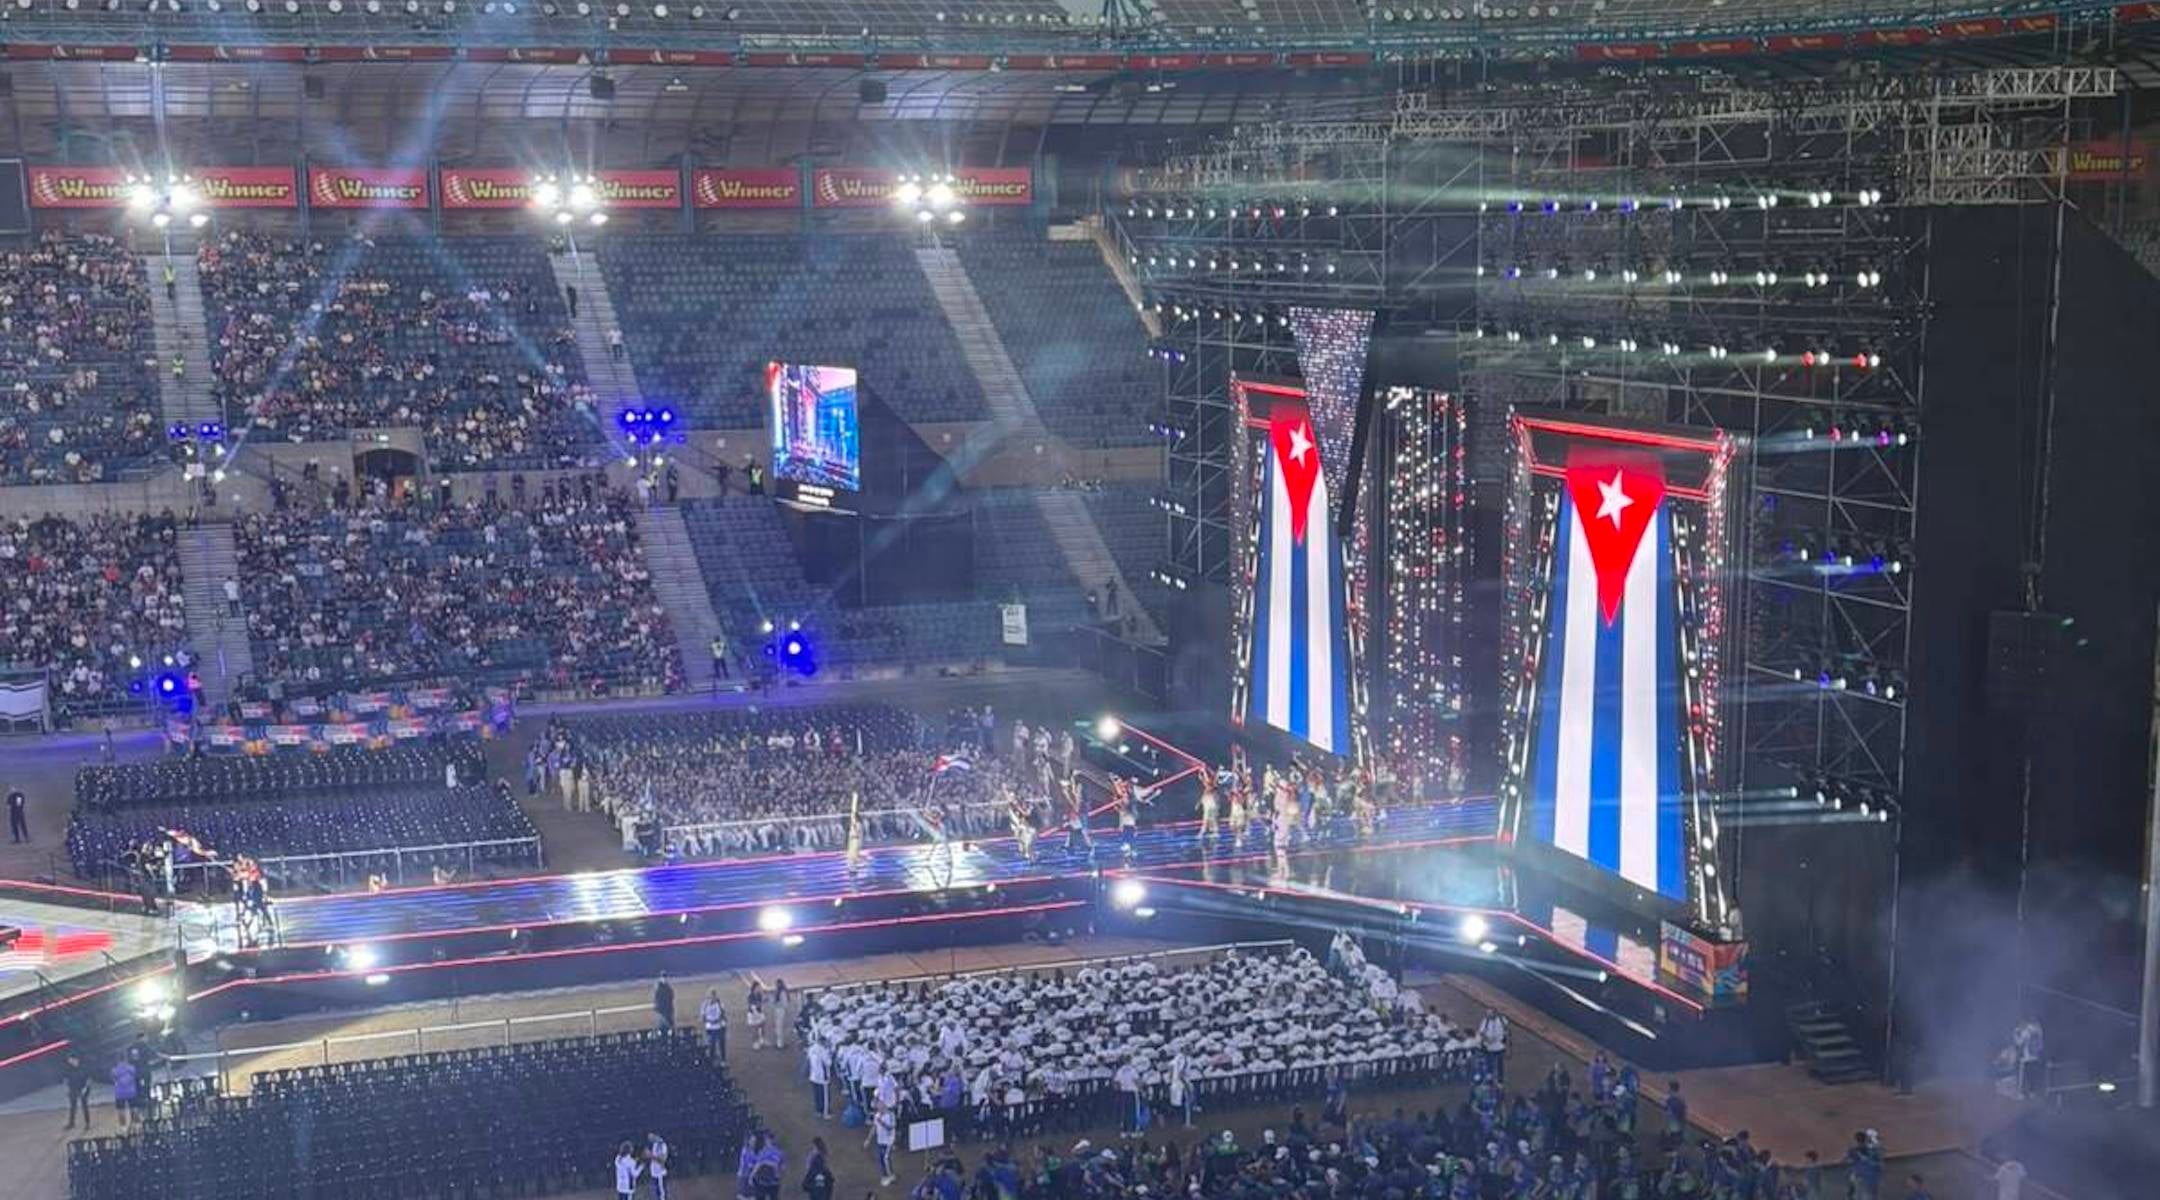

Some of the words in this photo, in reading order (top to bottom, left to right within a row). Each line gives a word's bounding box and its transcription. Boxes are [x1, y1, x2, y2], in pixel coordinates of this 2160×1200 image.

[2073, 151, 2145, 171] Winnr
[60, 178, 134, 198] Winn
[204, 178, 289, 198] Winner
[338, 178, 422, 199] Winner
[469, 179, 540, 199] Winn
[599, 179, 676, 200] Winner
[719, 179, 795, 198] Winner
